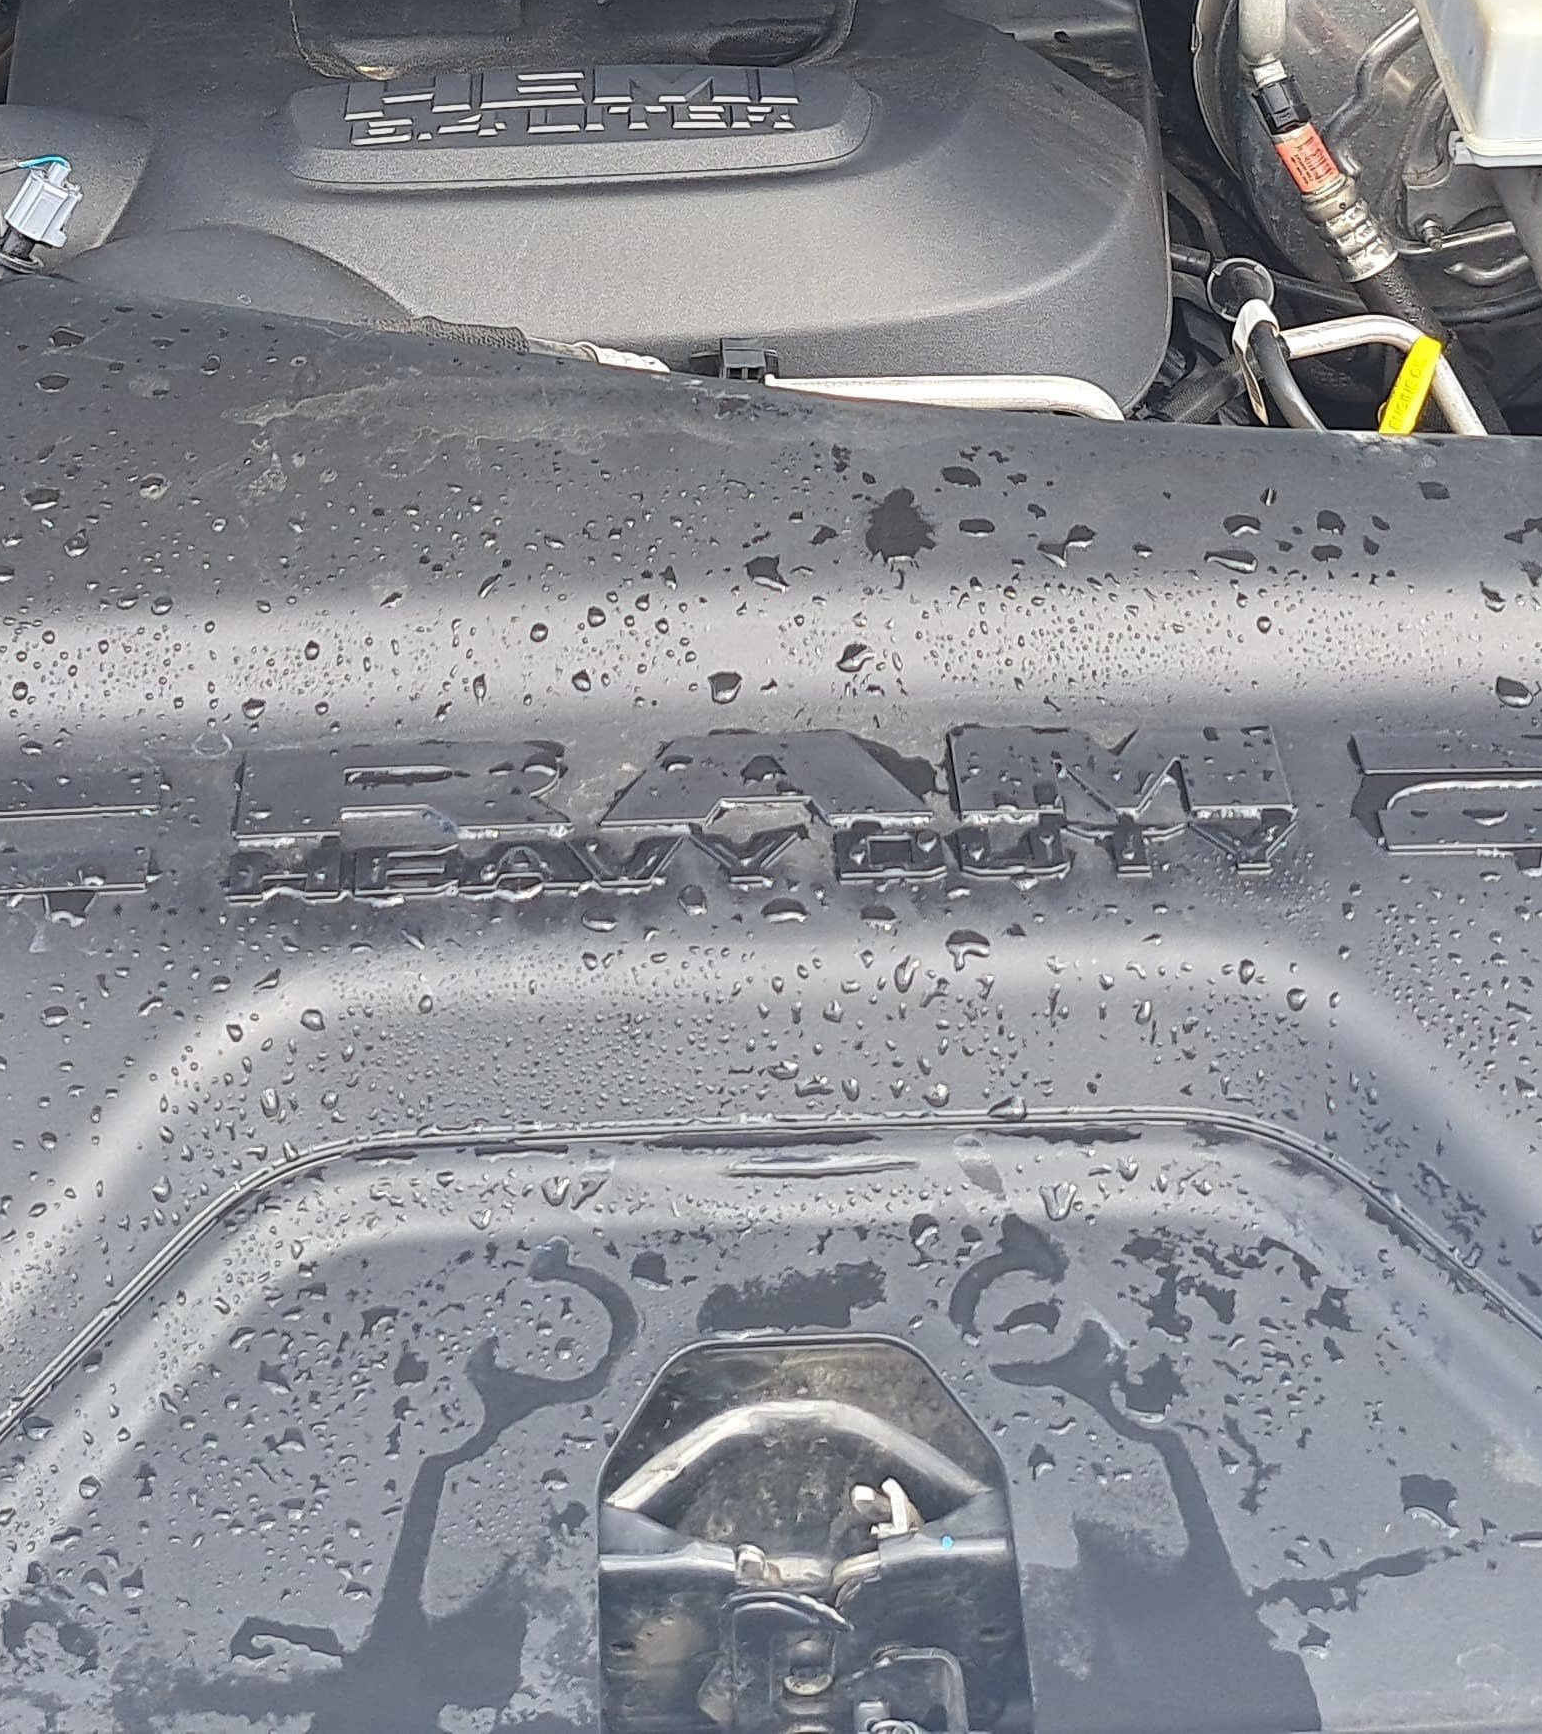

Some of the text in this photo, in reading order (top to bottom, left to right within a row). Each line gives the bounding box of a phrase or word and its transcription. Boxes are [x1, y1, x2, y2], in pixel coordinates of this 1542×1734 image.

[344, 68, 799, 121] HEMI
[526, 105, 796, 134] LITER
[231, 725, 1298, 845] RAM
[227, 812, 1298, 904] HEAVY DUTY
